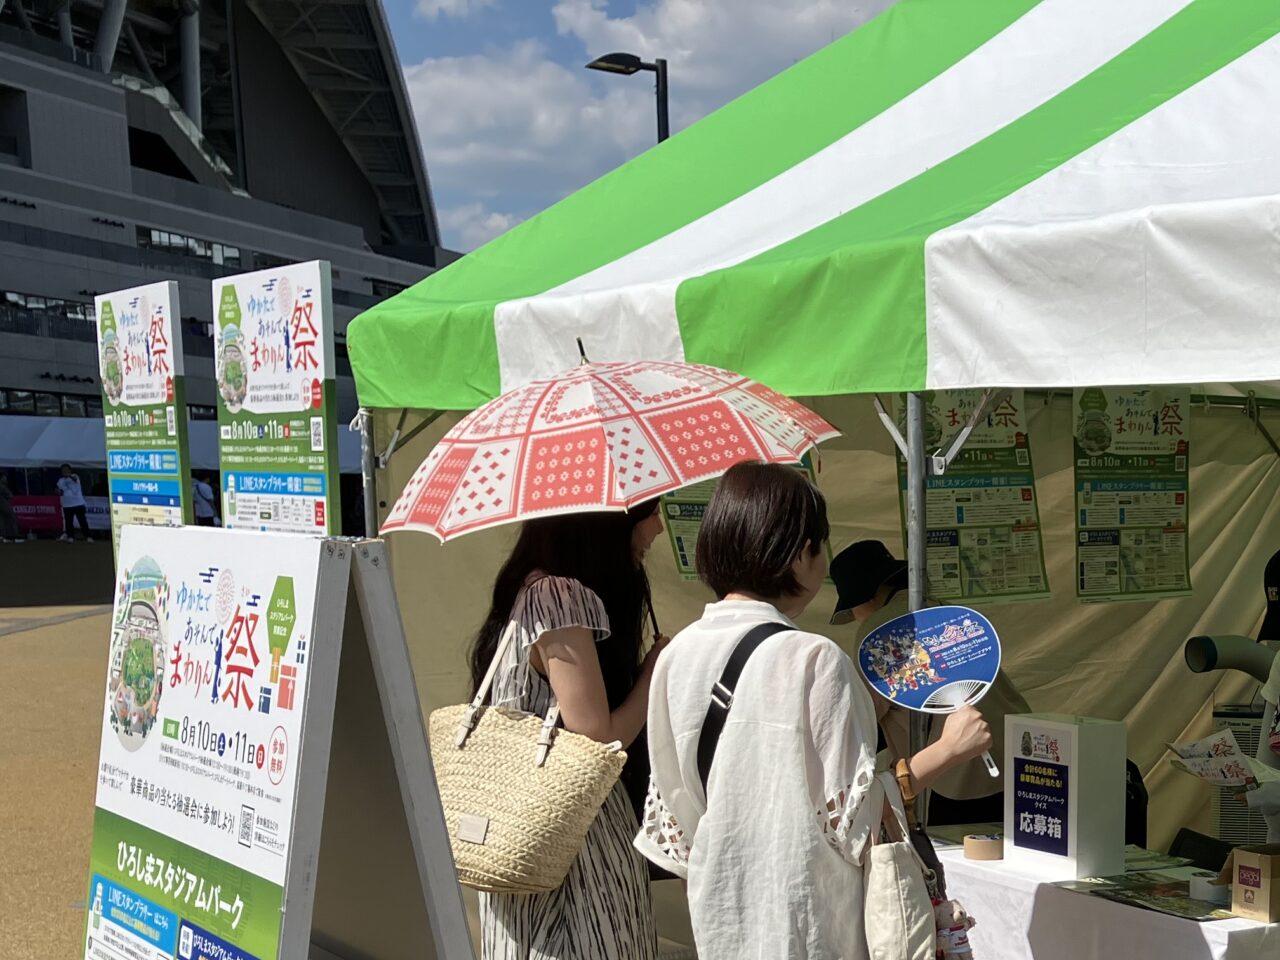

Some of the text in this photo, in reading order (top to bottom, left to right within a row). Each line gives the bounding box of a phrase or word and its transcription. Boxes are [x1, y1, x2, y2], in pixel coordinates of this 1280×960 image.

[150, 315, 169, 375] 祭
[291, 299, 318, 371] 祭
[1160, 402, 1184, 435] 祭
[177, 581, 212, 612] ゆかたで
[185, 617, 217, 645] あそんで
[170, 640, 212, 698] まわりん
[222, 604, 260, 711] 祭
[272, 737, 285, 755] 参加
[270, 756, 283, 774] 無料
[1035, 801, 1047, 809] クイズ
[1019, 811, 1062, 839] 応募箱
[117, 840, 244, 930] ひろしまスタジアムパーク
[108, 886, 153, 920] LINEスタンプラリー
